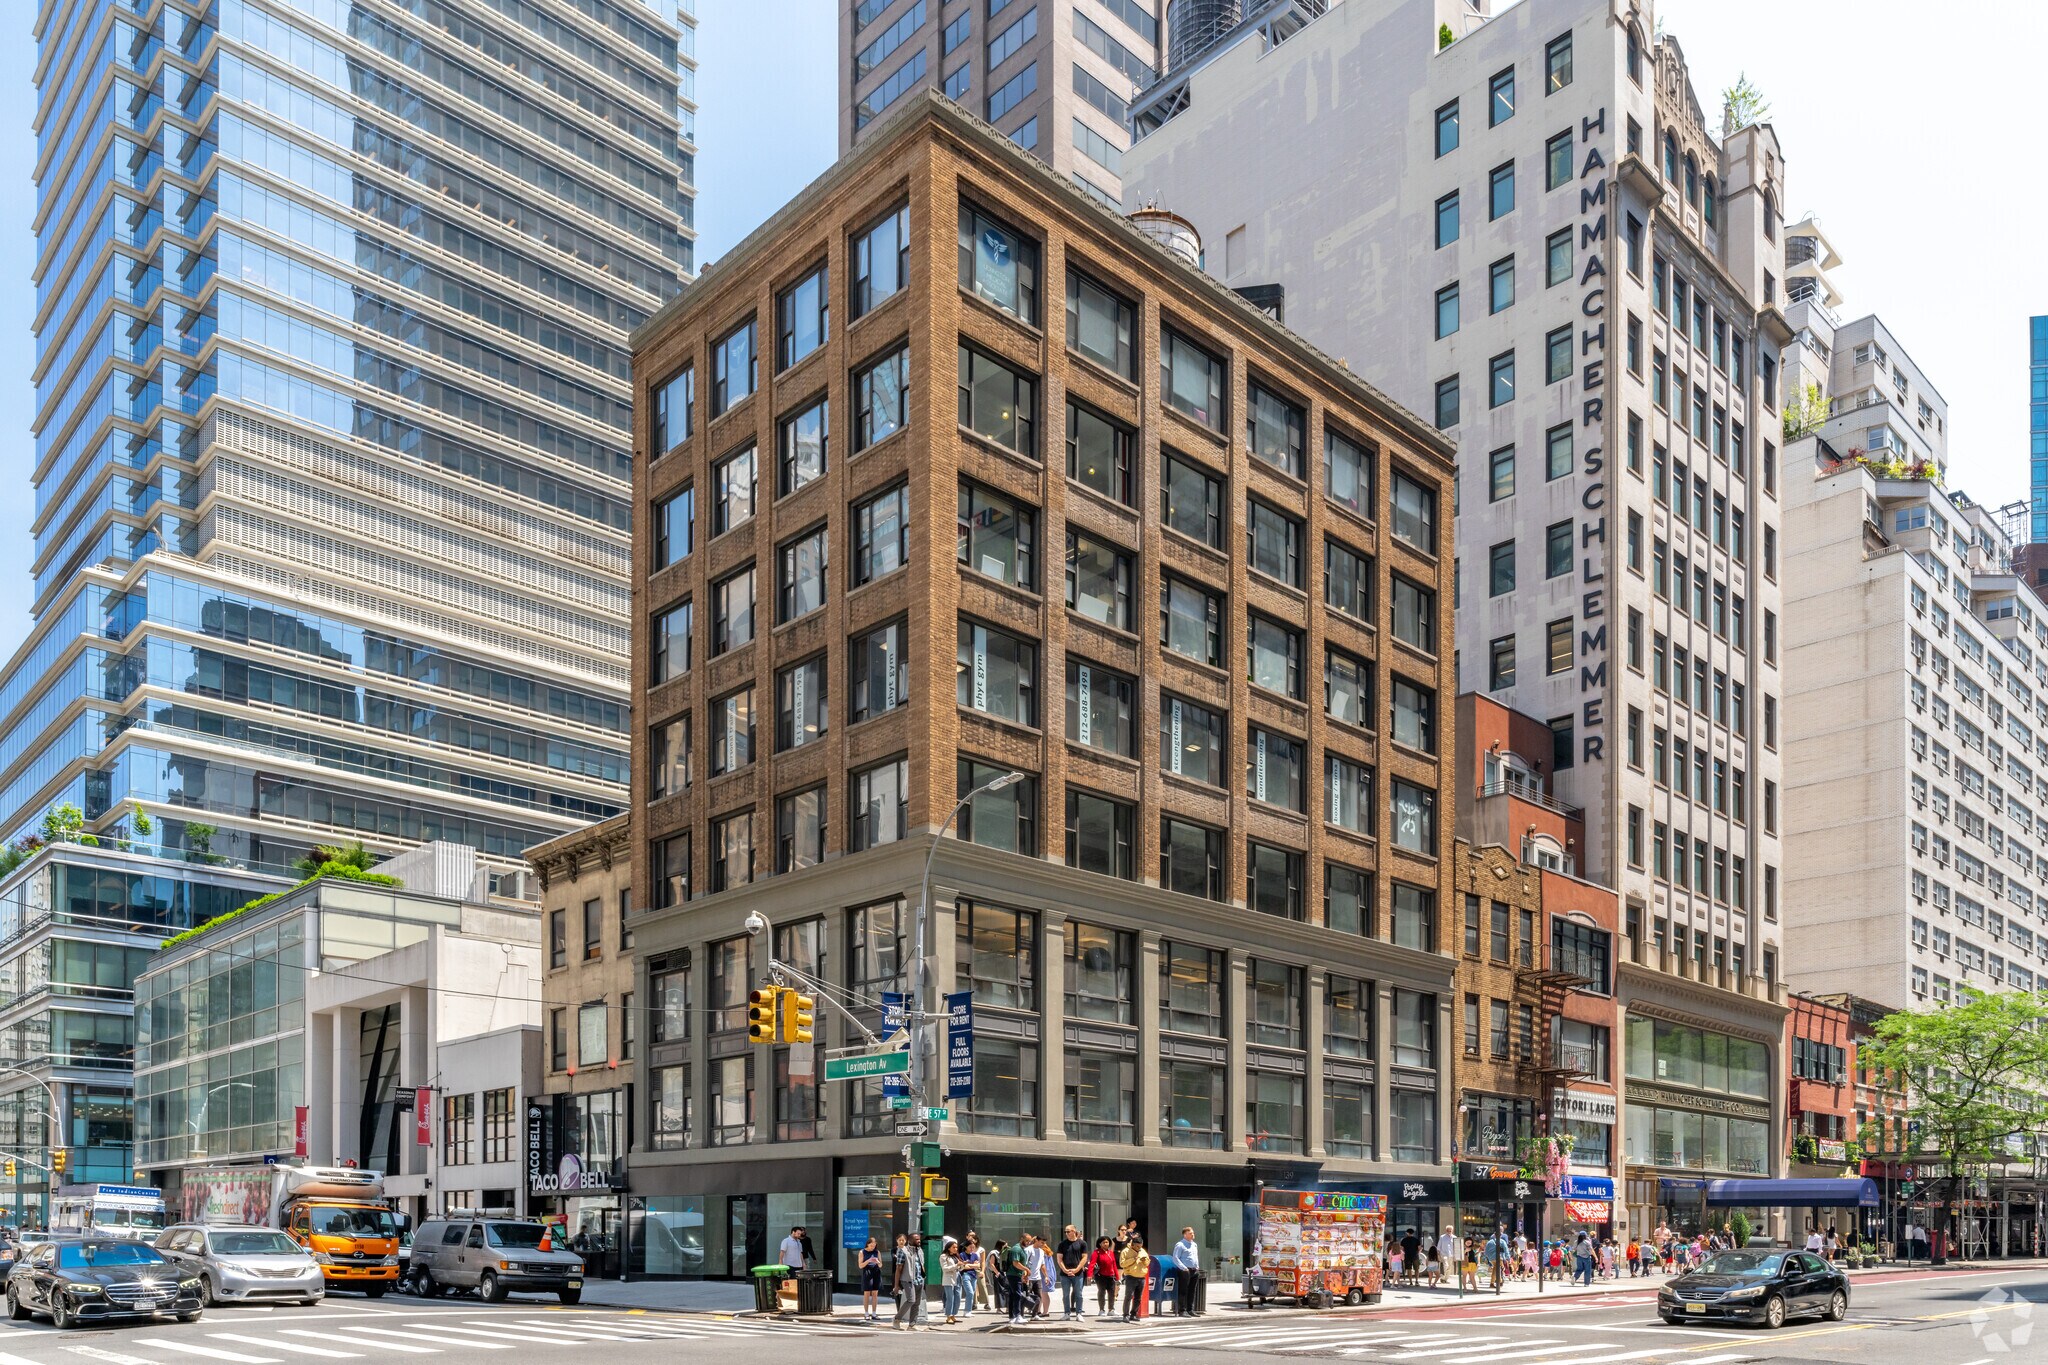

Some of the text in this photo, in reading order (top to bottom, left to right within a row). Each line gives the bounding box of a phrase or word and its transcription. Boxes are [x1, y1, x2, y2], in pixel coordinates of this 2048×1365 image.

[1580, 107, 1607, 763] HAMMACHER SCHLEMMER
[976, 654, 985, 707] phyt gym
[1173, 704, 1181, 769] strengthening
[888, 1006, 904, 1015] STOR
[953, 1005, 966, 1016] STORE
[950, 1015, 970, 1026] FOR RENT
[955, 1037, 966, 1046] FULL
[952, 1047, 969, 1057] FLOORS
[846, 1059, 887, 1074] Lexington Av
[950, 1058, 972, 1068] AVAILABLE
[1555, 1097, 1615, 1116] SATORI LASER
[934, 1109, 941, 1119] 57
[1482, 1125, 1511, 1145] Psychic
[529, 1121, 540, 1178] TACO BELL
[1489, 1166, 1518, 1179] Gourmet
[530, 1171, 609, 1190] TACO BELL
[1403, 1190, 1429, 1200] Bagels
[1588, 1187, 1606, 1196] NAILS
[1331, 1195, 1378, 1209] CHICKEN
[1577, 1201, 1604, 1211] GRAND
